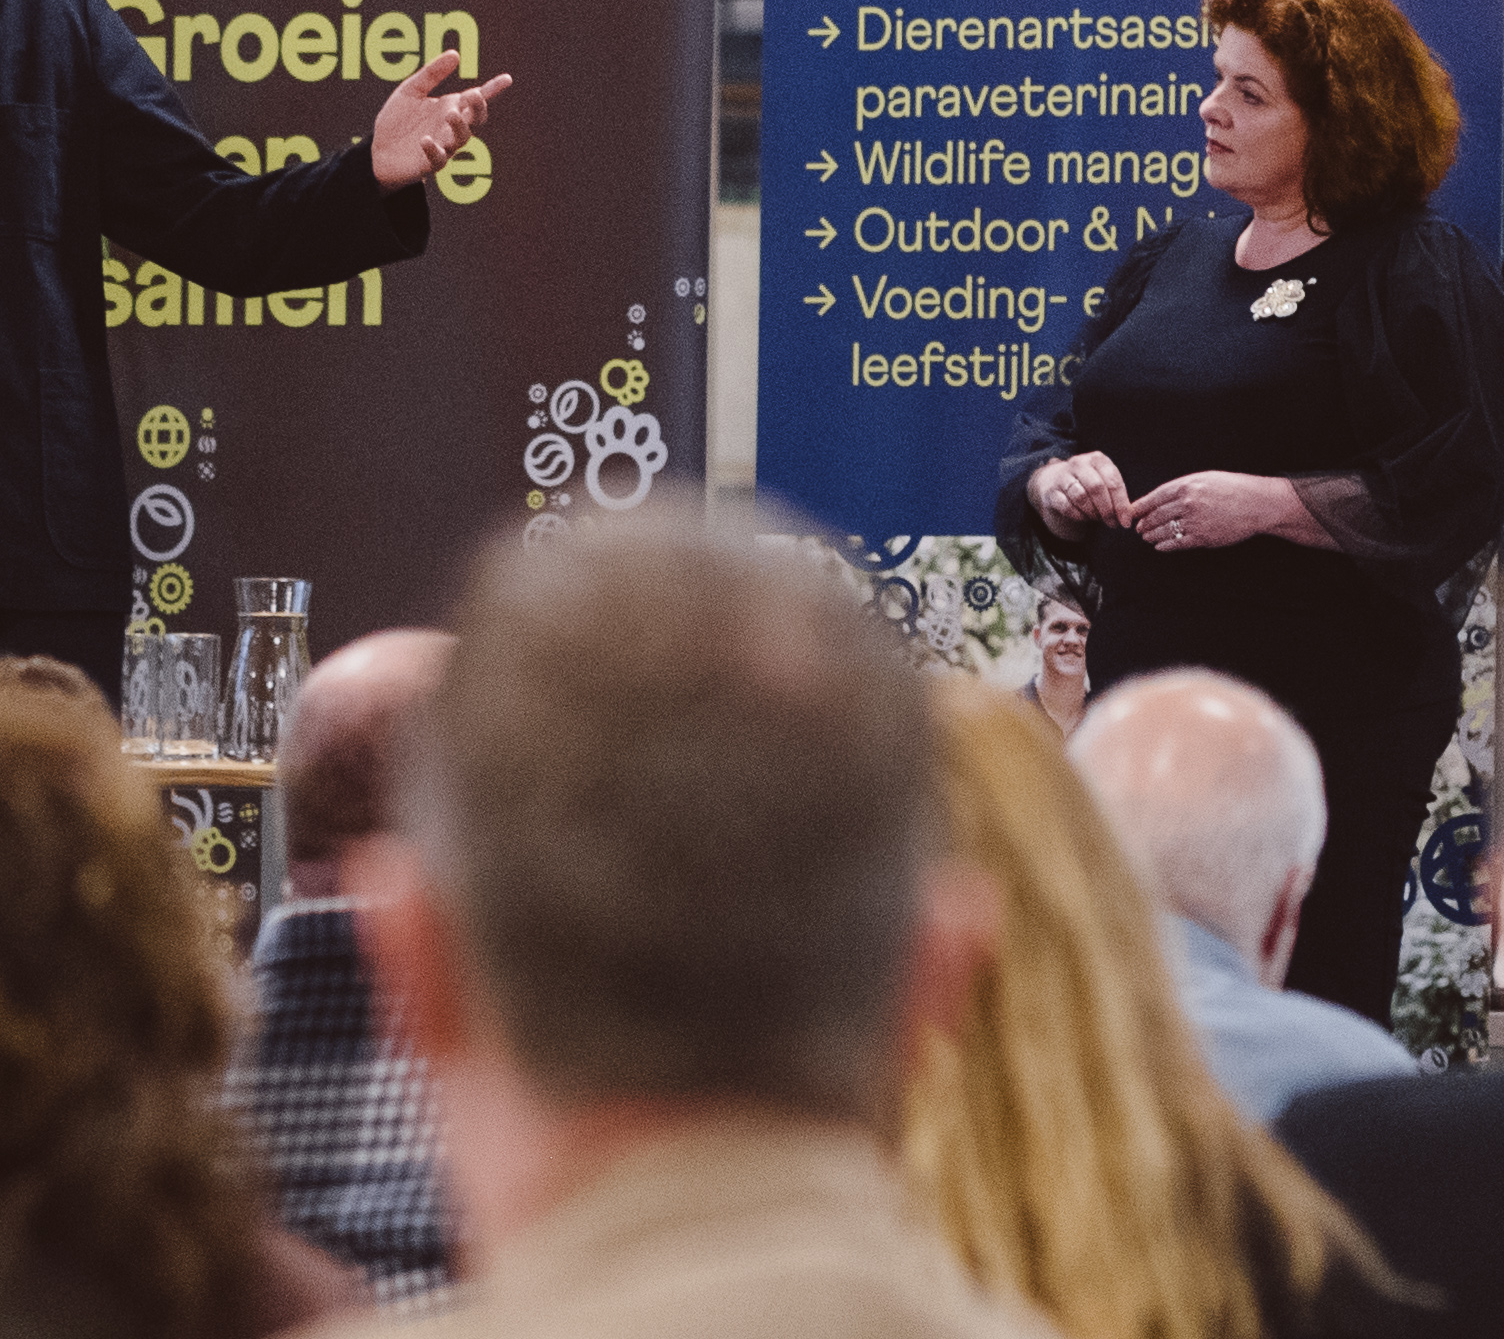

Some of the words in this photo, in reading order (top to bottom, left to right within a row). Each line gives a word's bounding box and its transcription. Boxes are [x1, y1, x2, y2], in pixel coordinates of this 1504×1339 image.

[857, 6, 1218, 52] Dierenartsassi
[855, 73, 1203, 132] paraveterinair
[855, 140, 1031, 186] Wildlife
[1048, 151, 1211, 198] manag
[853, 209, 1070, 254] Outdoor
[1083, 205, 1119, 252] &
[853, 275, 1068, 333] Voeding-
